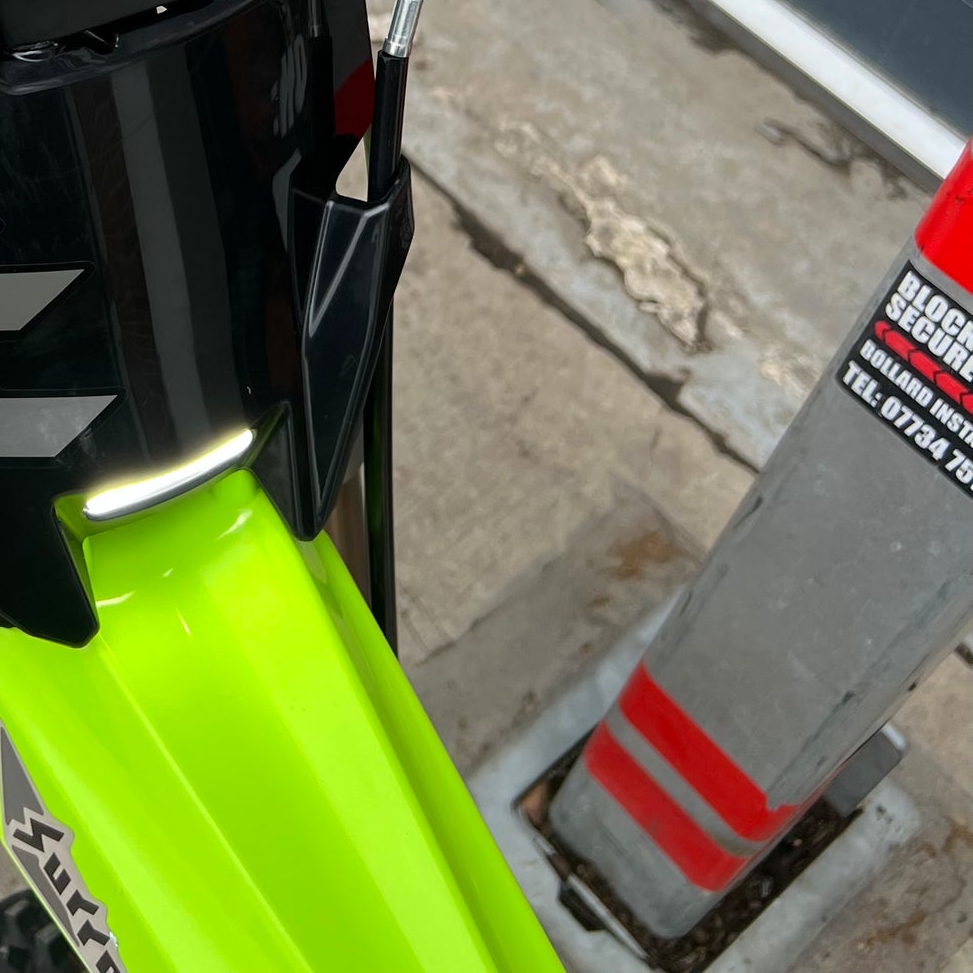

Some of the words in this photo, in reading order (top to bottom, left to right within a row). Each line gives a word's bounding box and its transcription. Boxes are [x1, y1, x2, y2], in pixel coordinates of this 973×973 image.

[860, 339, 934, 408] BOLLARD
[842, 360, 884, 408] TEL:
[881, 396, 950, 461] 07734
[945, 448, 973, 491] 75
